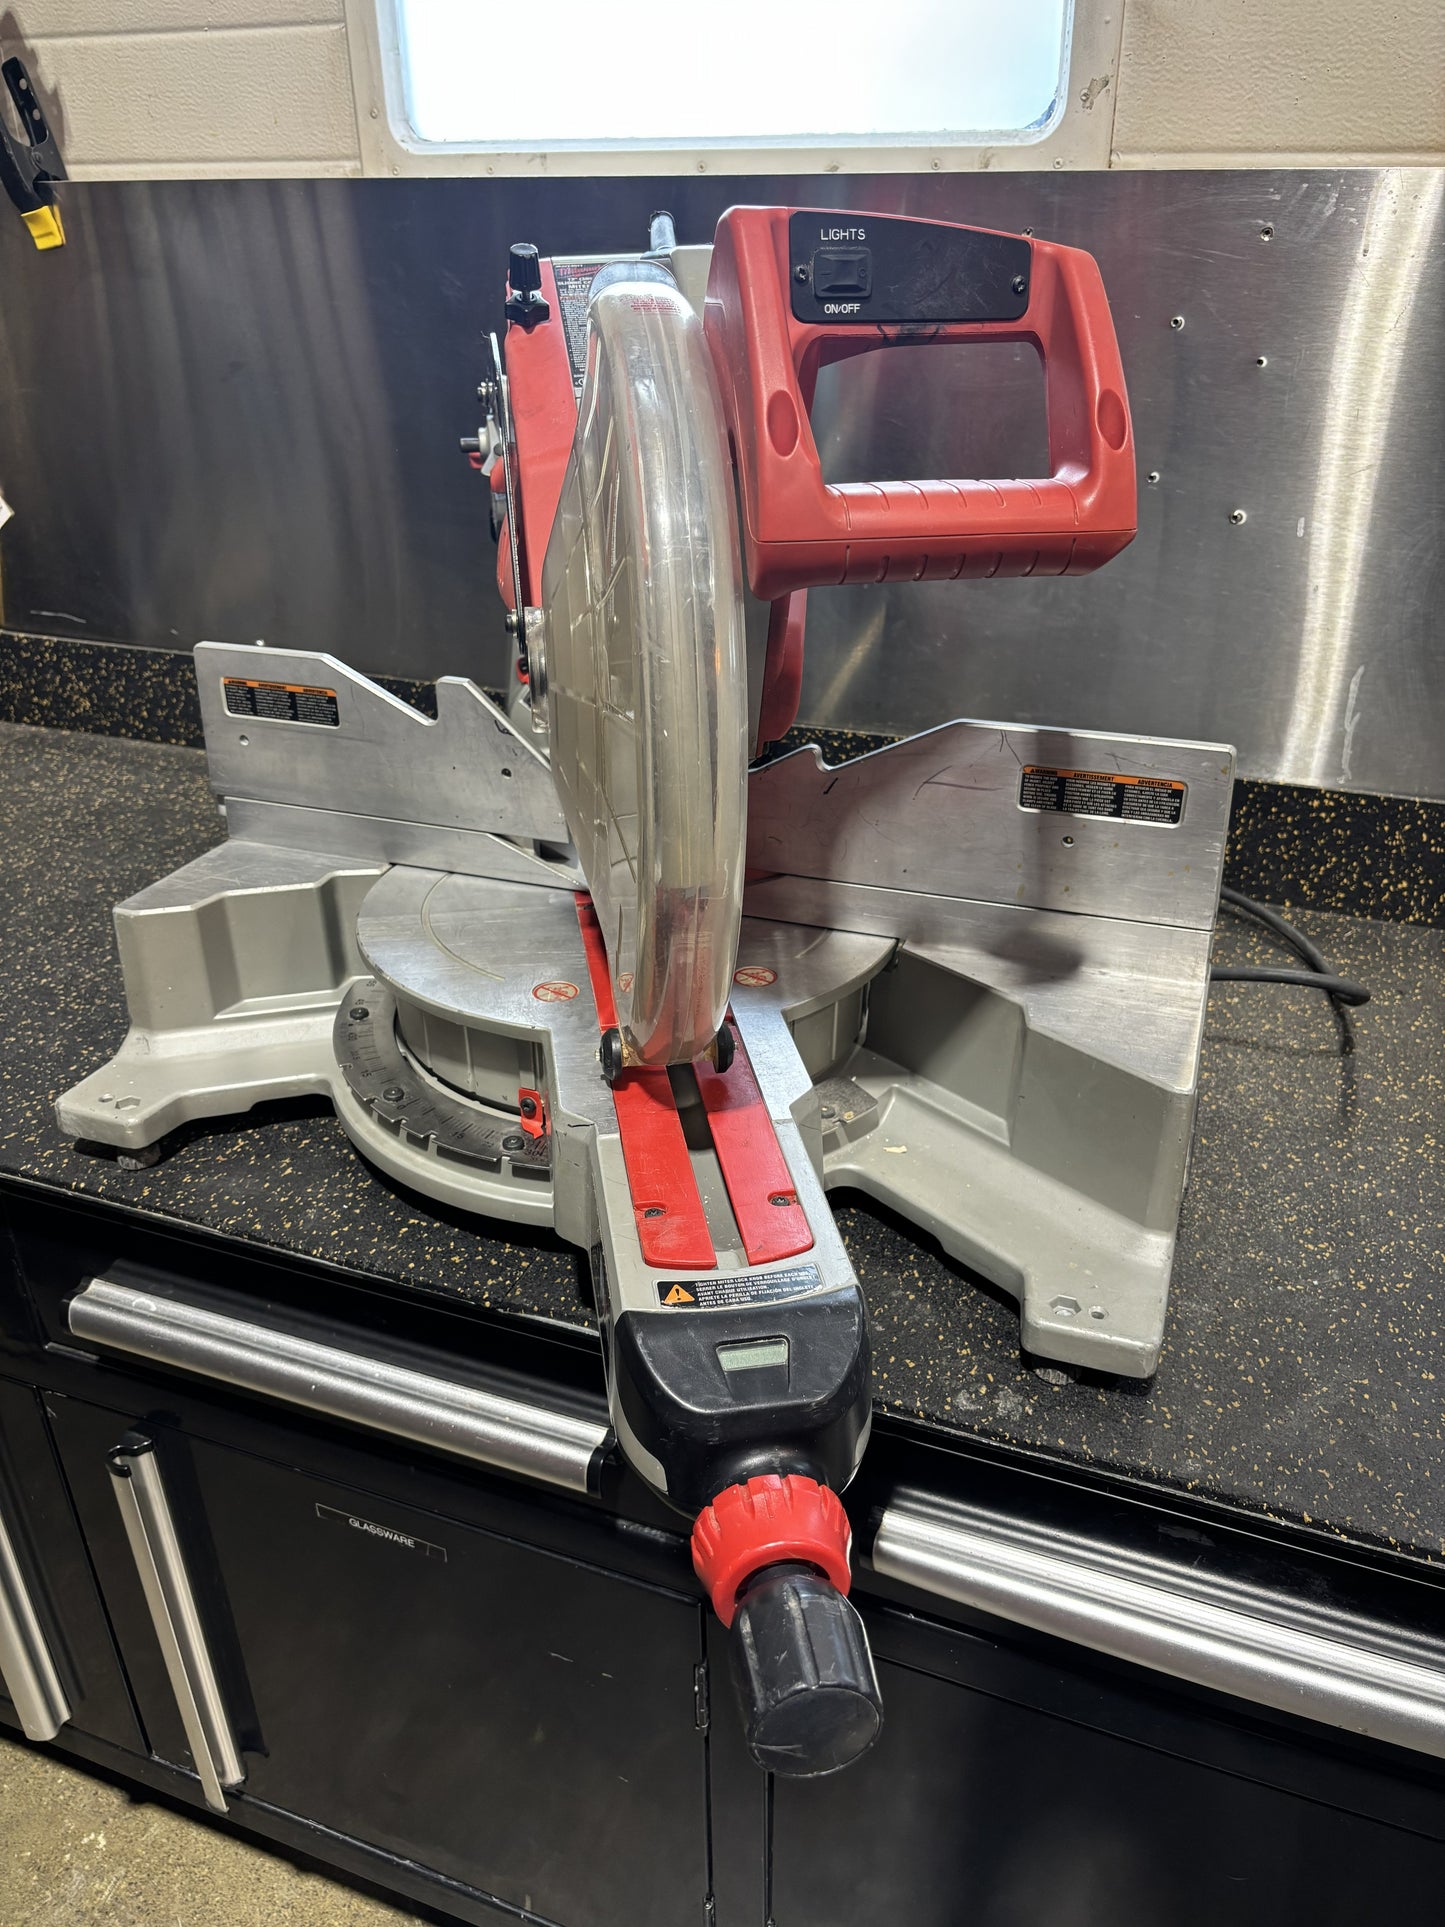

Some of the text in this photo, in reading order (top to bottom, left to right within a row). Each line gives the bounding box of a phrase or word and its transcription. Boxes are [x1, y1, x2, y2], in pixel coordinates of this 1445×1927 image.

[820, 228, 866, 241] LIGHTS
[824, 303, 860, 314] ON/OFF
[1073, 772, 1114, 782] AVERTISSEMENT
[1138, 779, 1173, 788] ADVERTENCIA
[754, 1277, 790, 1286] VERROUILLAGE
[348, 1518, 415, 1548] GLASSWARE
